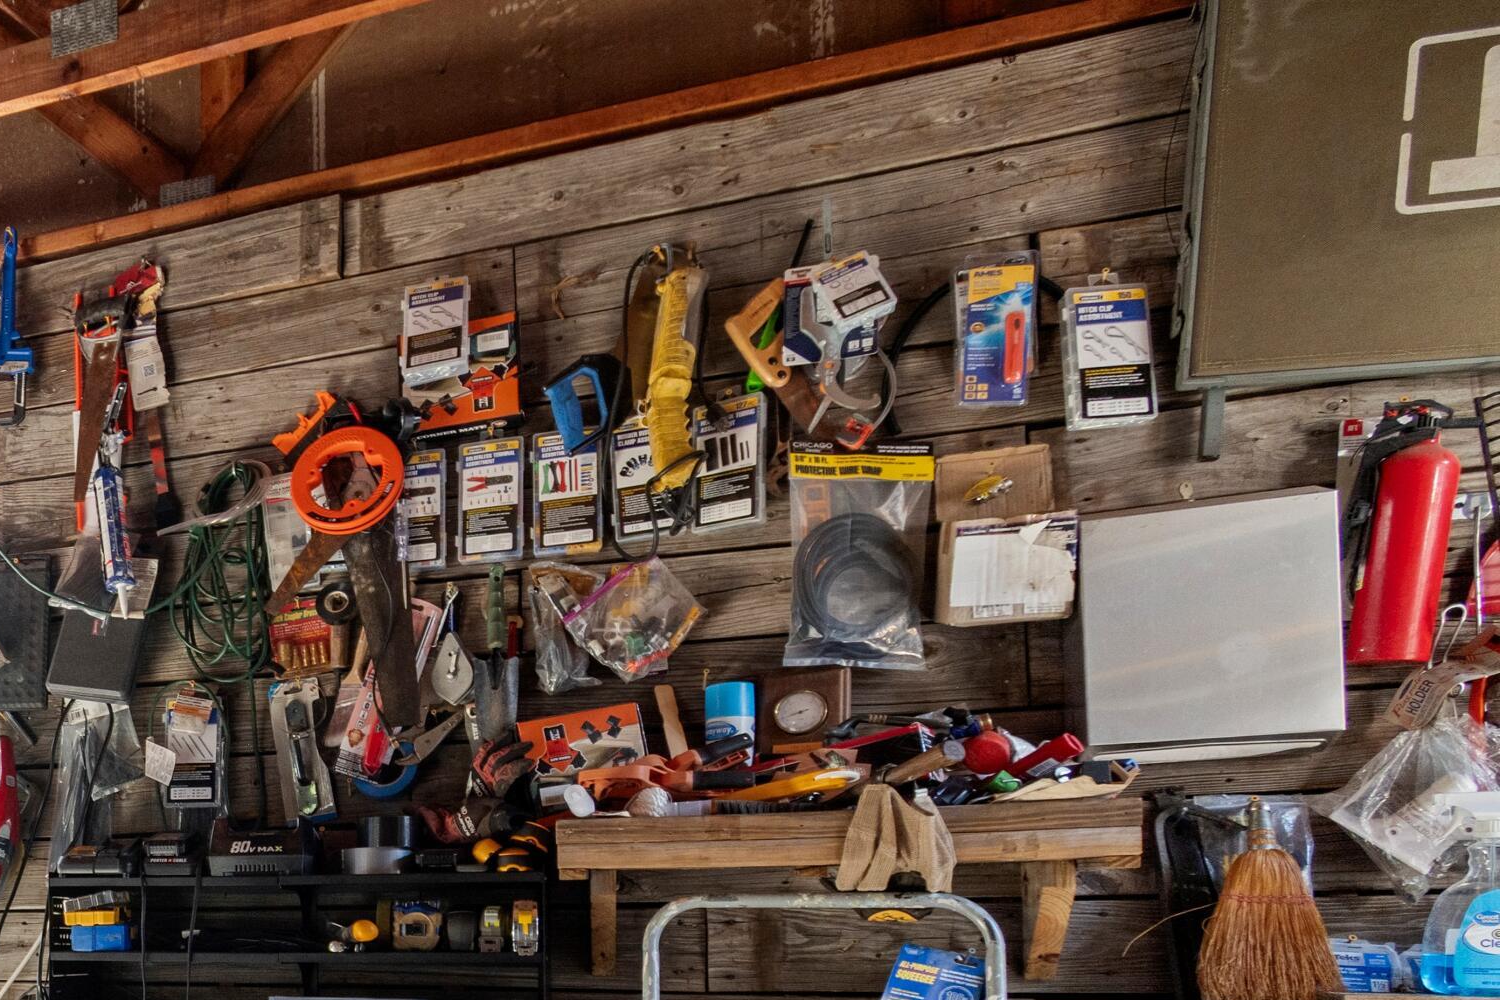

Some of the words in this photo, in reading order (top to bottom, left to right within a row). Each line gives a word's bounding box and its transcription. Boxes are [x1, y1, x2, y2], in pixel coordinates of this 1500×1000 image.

[792, 441, 834, 450] CHICAGO
[795, 464, 837, 476] PROTECTIVE
[838, 465, 861, 475] WIRE
[861, 465, 883, 476] WRAP
[1405, 679, 1435, 716] HOLDER
[257, 845, 284, 853] MAX
